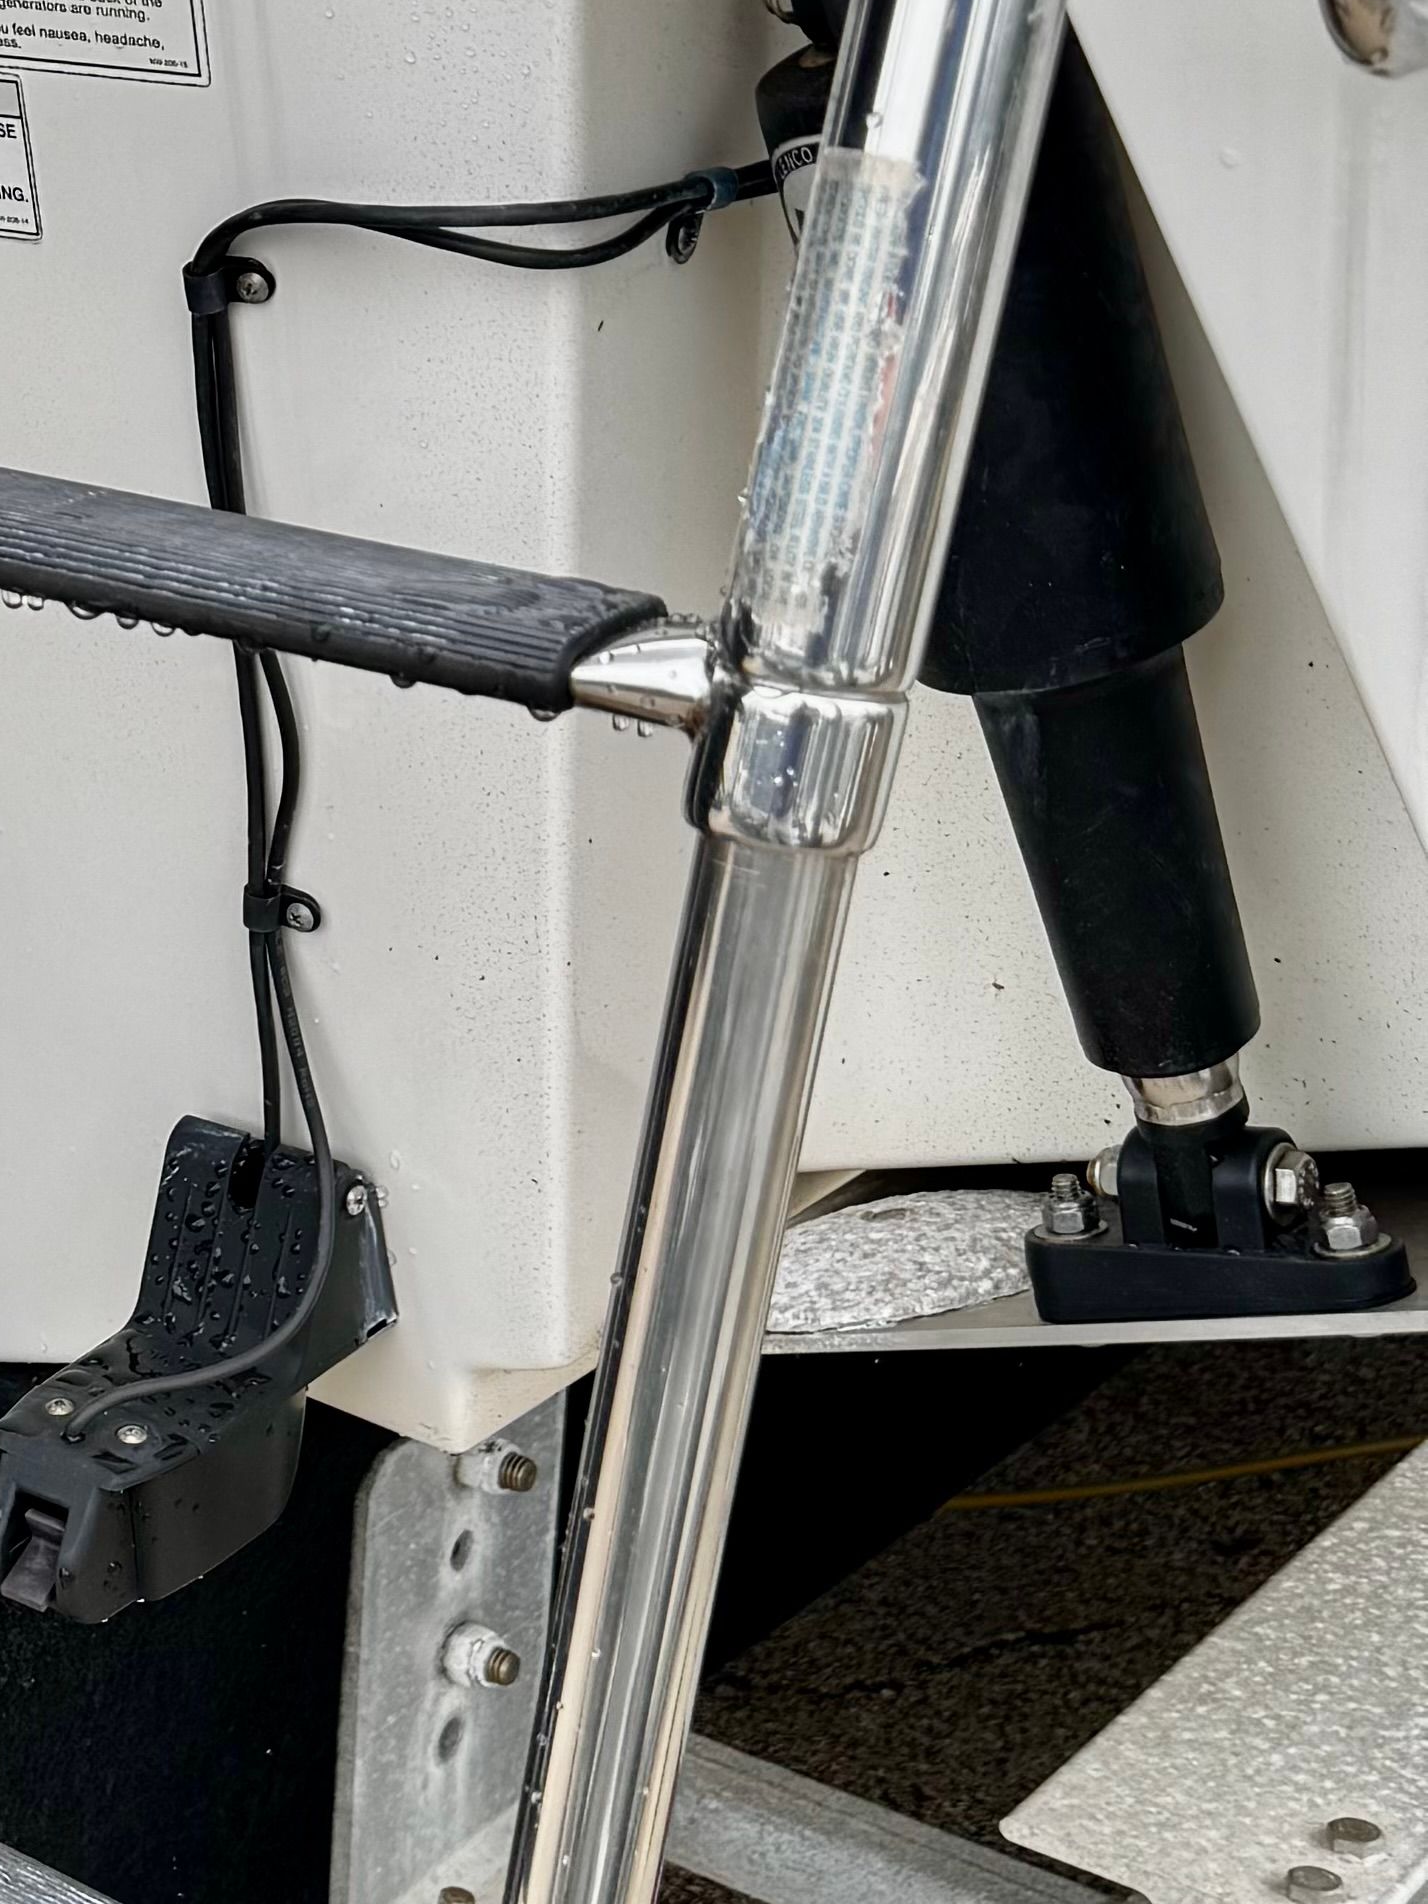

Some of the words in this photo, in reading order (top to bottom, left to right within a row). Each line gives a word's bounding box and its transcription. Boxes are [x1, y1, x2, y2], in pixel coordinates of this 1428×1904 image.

[70, 4, 91, 15] are
[96, 6, 150, 23] running.
[12, 22, 36, 37] feel
[39, 28, 91, 43] nausea,
[94, 30, 164, 51] headache,
